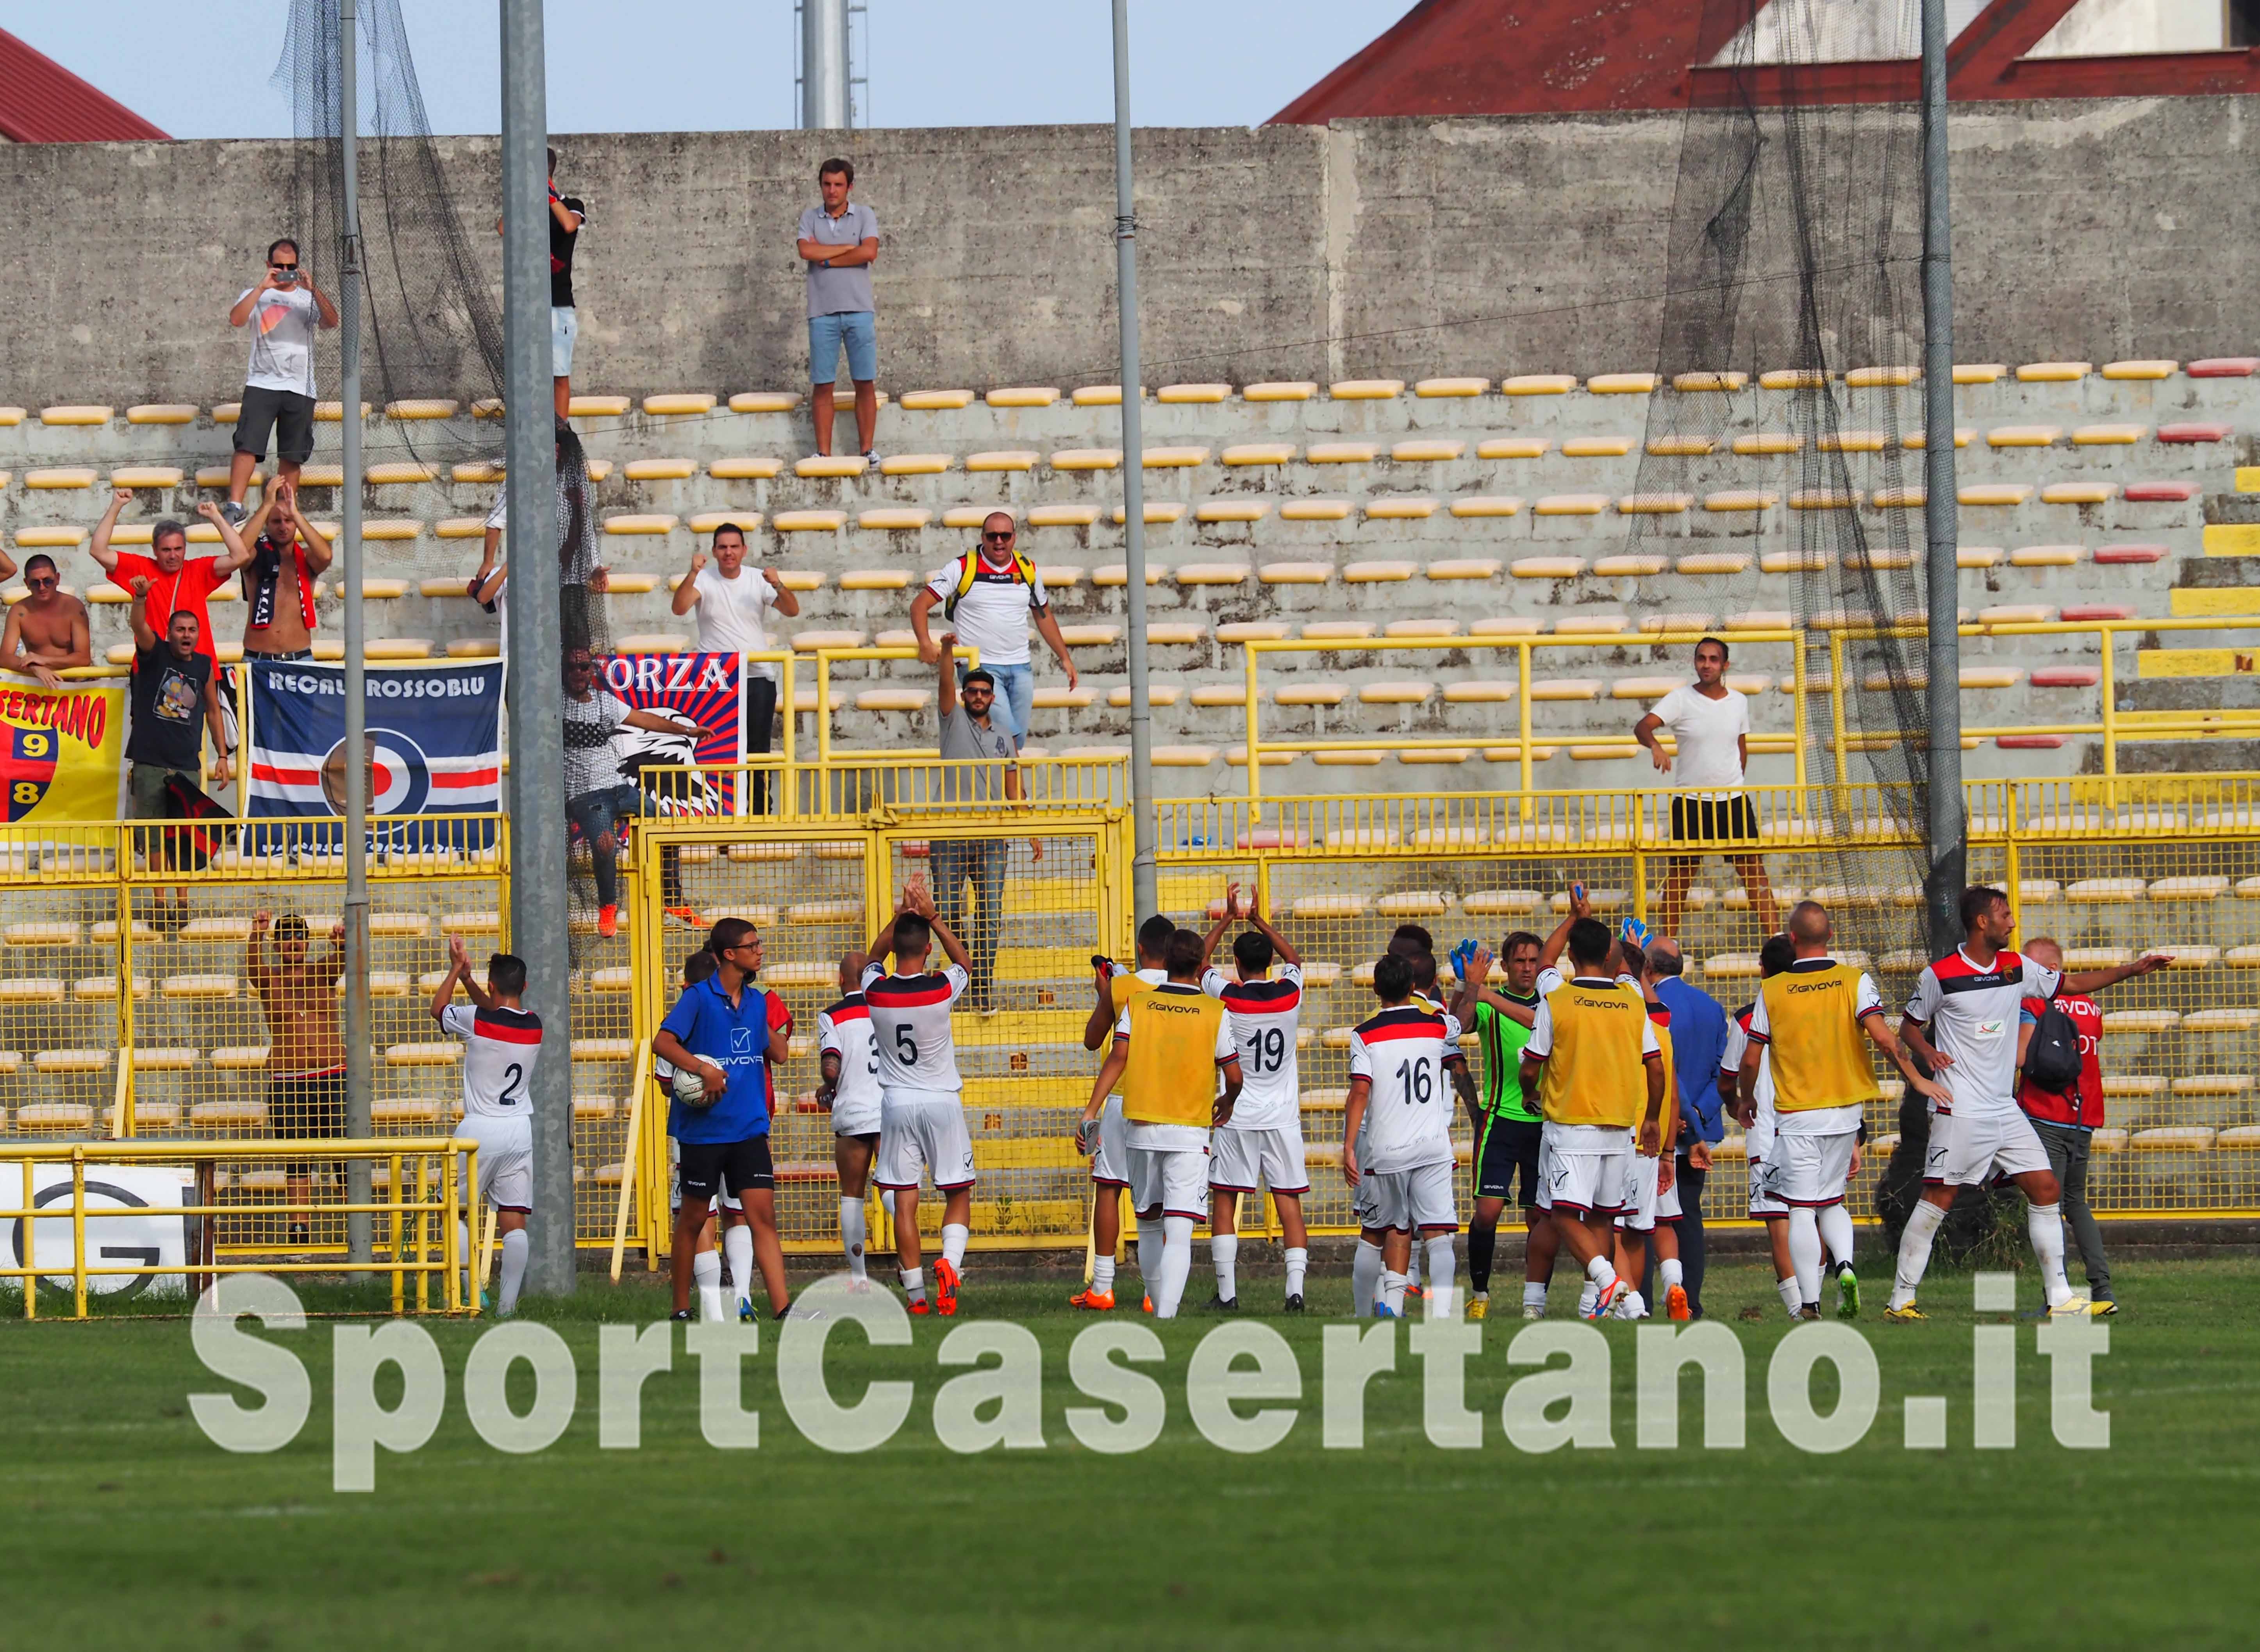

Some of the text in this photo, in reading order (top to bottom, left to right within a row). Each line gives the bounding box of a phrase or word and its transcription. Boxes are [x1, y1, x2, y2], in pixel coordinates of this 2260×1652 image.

[269, 671, 485, 698] RECAL ROSSOBLU
[592, 658, 733, 694] ORZA
[23, 734, 49, 757] 9
[13, 782, 39, 805] 8
[1798, 980, 1842, 993] GIVOVA
[1155, 1003, 1200, 1015] GIVOVA
[1584, 1000, 1629, 1011] GIVOVA
[896, 1024, 918, 1066] 5
[1246, 1028, 1284, 1072] 19
[499, 1063, 523, 1106] 2
[1396, 1056, 1432, 1105] 16
